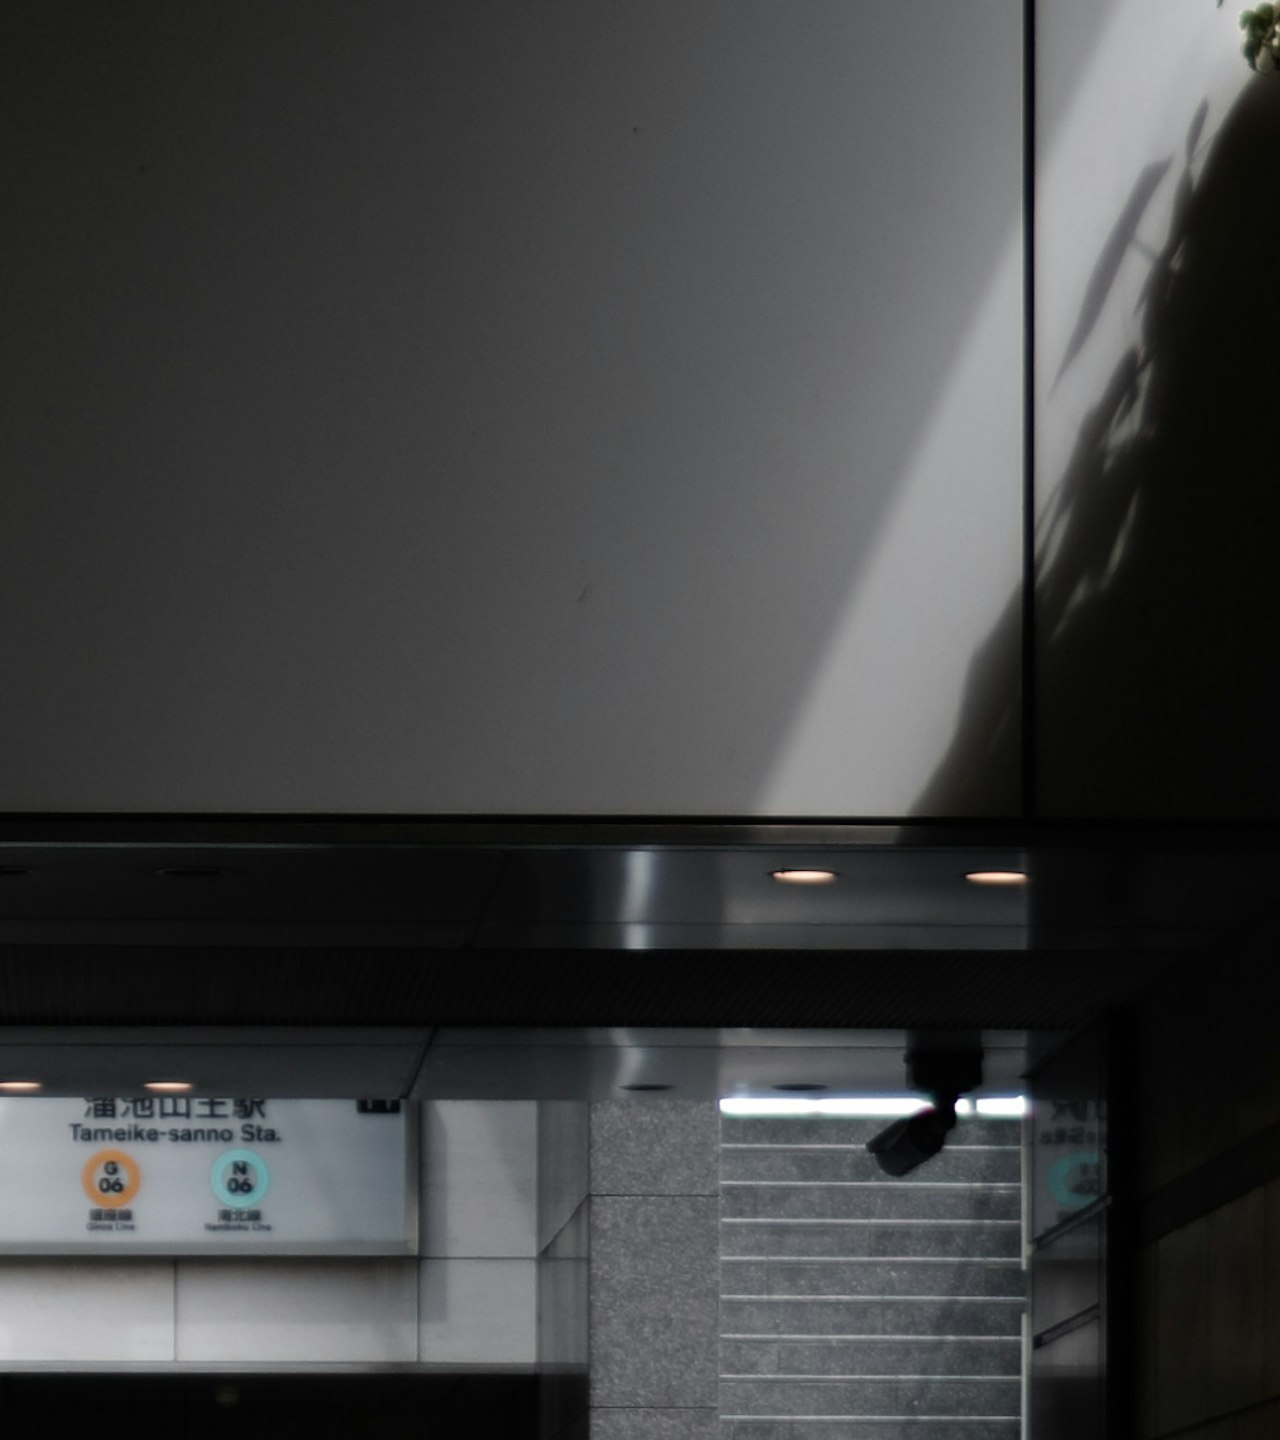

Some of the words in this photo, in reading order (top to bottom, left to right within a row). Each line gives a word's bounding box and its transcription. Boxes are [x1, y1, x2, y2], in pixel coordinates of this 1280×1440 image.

[70, 1123, 233, 1142] Tameike-sanno
[240, 1123, 281, 1142] Sta.
[104, 1161, 118, 1175] G
[233, 1161, 248, 1175] N
[98, 1178, 124, 1194] 06
[227, 1178, 253, 1194] 06
